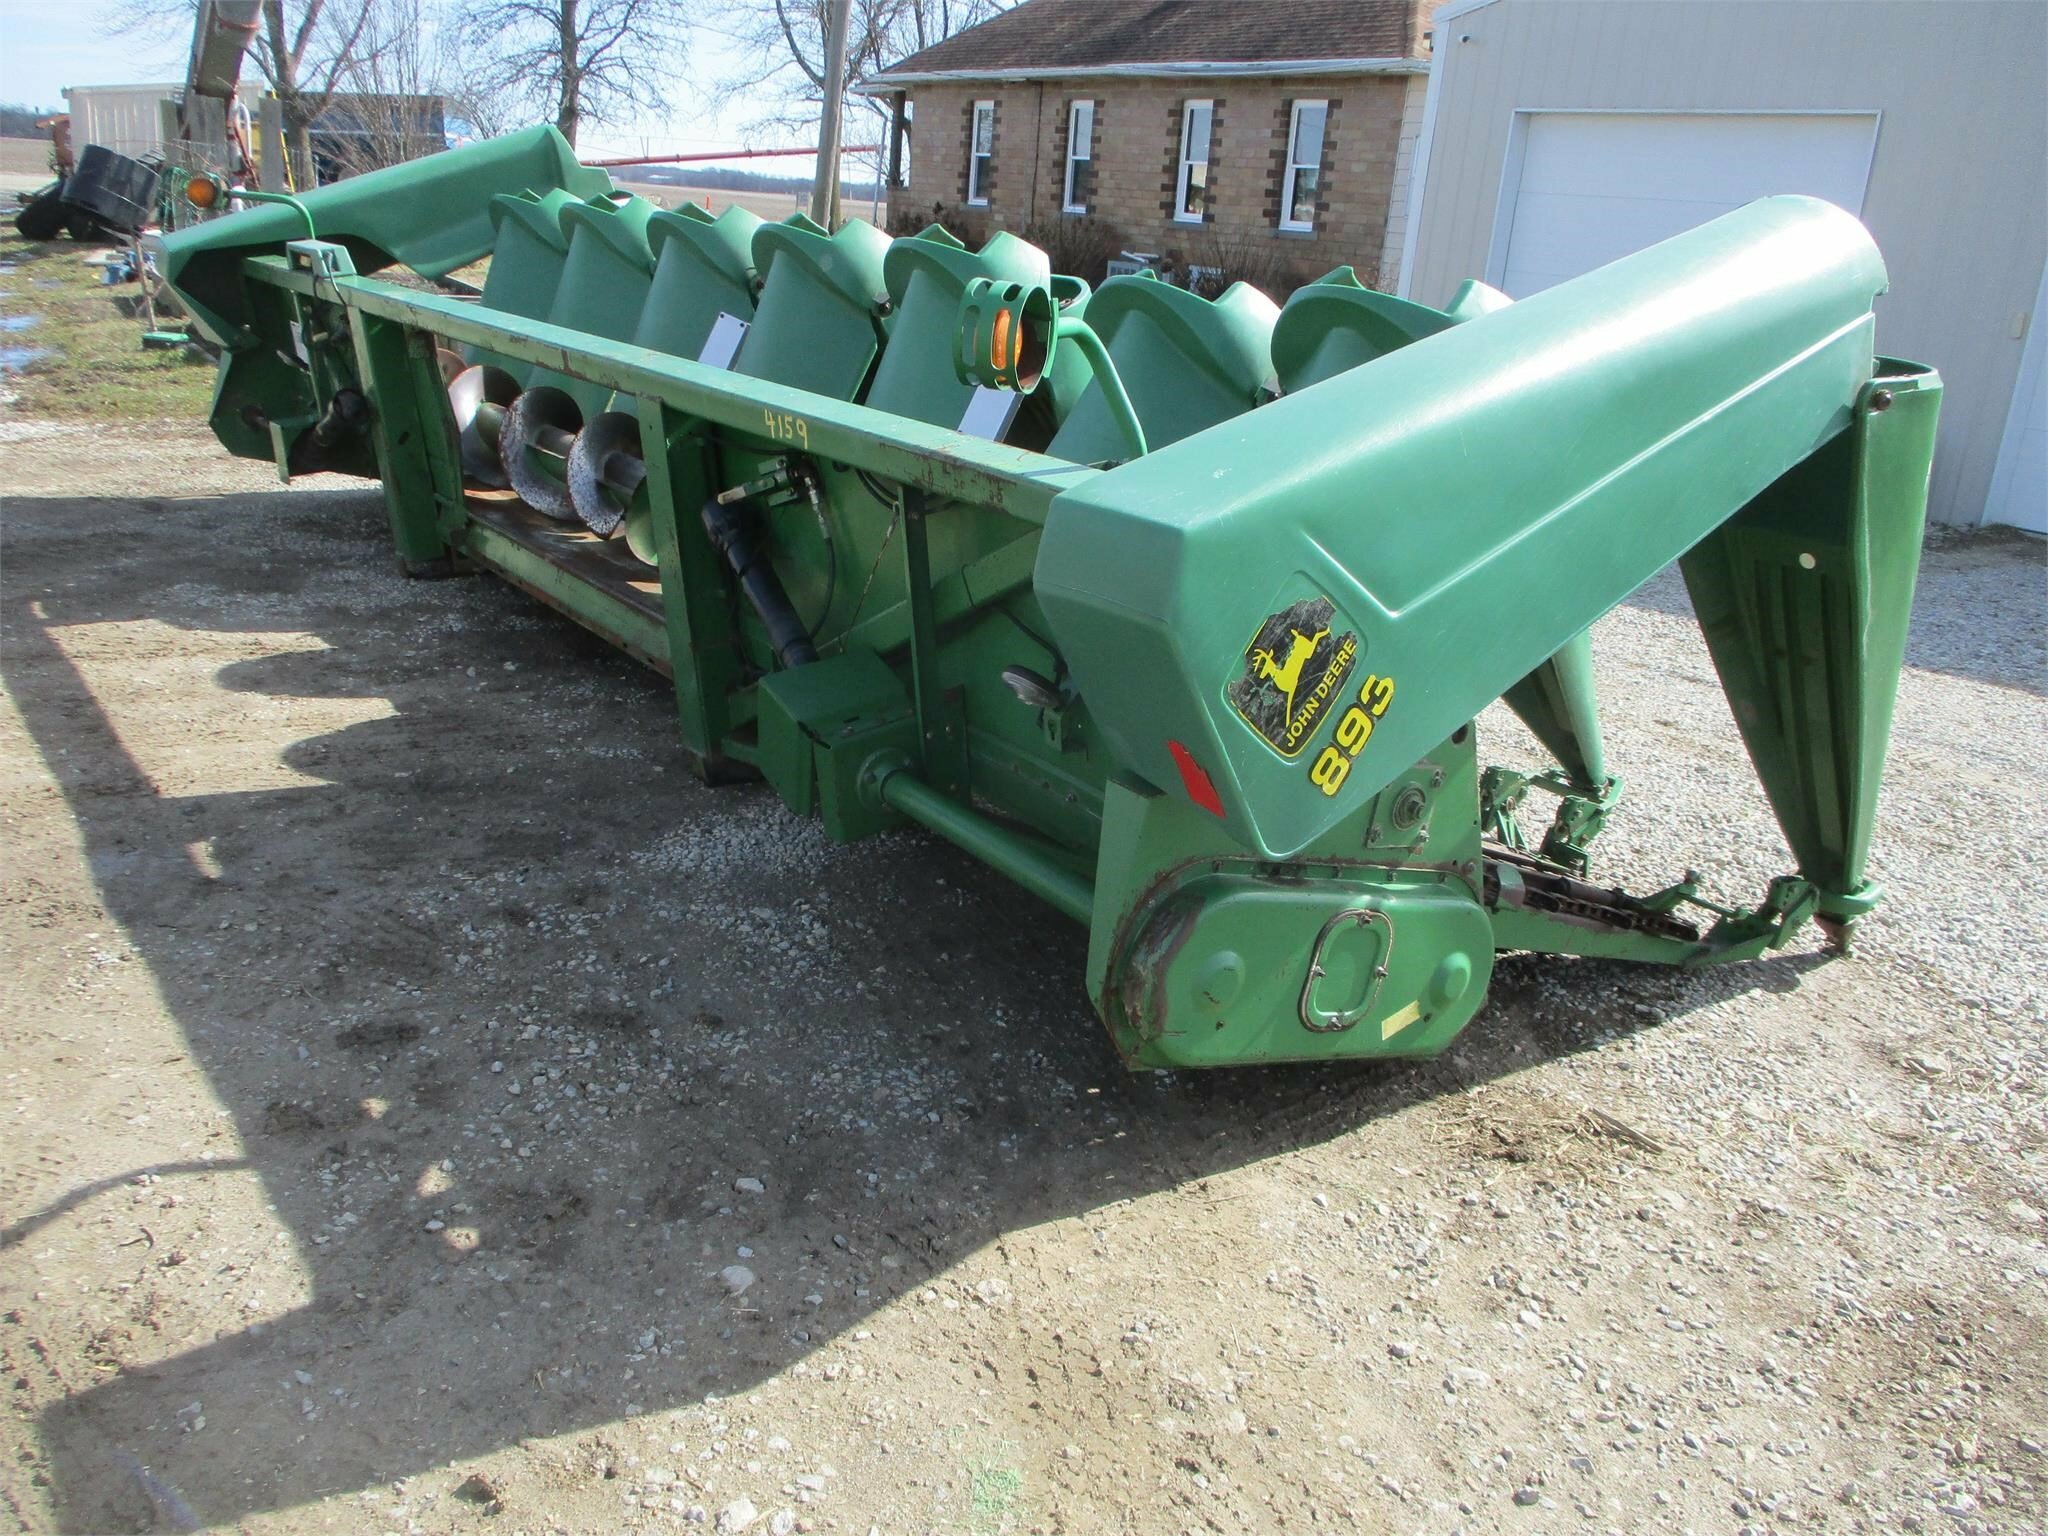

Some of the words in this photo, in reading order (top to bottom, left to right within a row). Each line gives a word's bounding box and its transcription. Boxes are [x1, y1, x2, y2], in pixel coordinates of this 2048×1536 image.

[764, 408, 808, 449] 4159
[1286, 696, 1319, 747] JOHN
[1315, 638, 1356, 699] DEERE
[1311, 674, 1395, 796] 893
